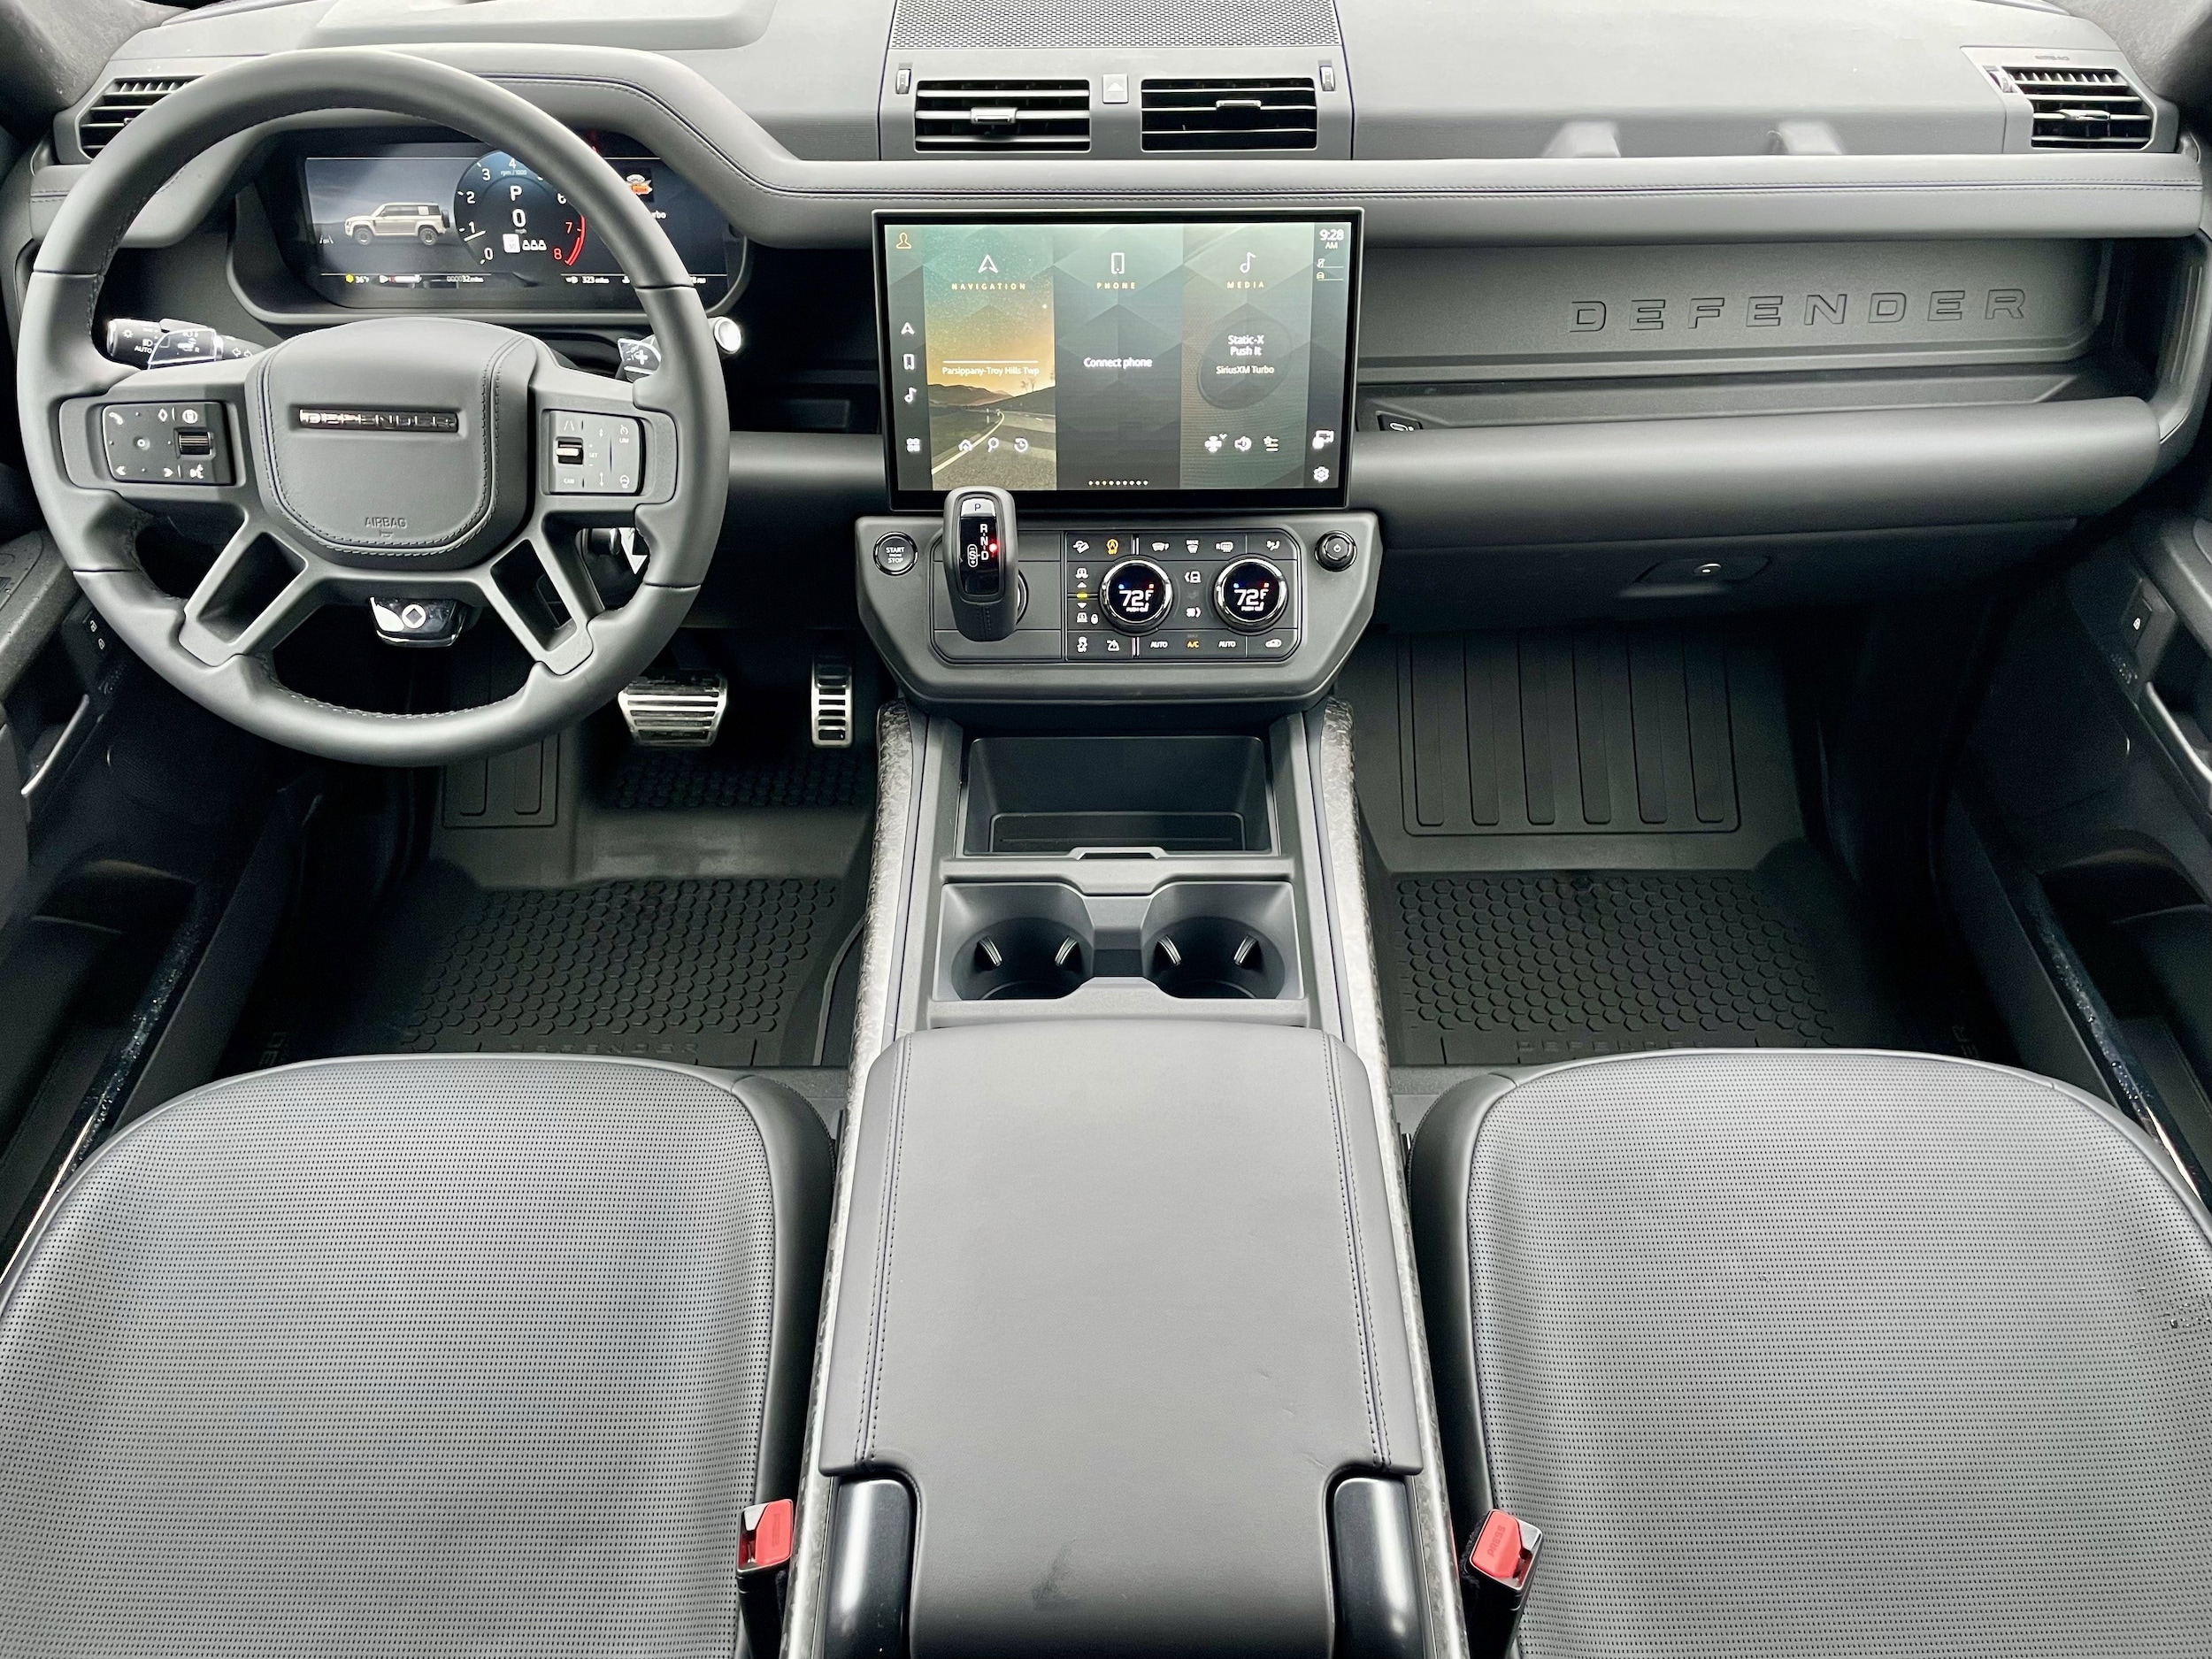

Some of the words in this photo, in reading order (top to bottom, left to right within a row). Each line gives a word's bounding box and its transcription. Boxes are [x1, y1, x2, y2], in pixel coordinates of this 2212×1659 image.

[509, 157, 517, 169] 4
[481, 168, 491, 181] 3
[466, 190, 476, 204] 2
[510, 185, 522, 201] P
[512, 209, 526, 228] 0
[468, 221, 476, 234] 1
[565, 221, 573, 234] 7
[1319, 228, 1345, 242] 9:28
[484, 247, 494, 261] 0
[553, 248, 563, 260] 8
[951, 282, 1026, 291] NAVIGATION
[1226, 280, 1265, 289] MEDIA
[1569, 288, 2025, 333] DEFENDER
[1227, 334, 1265, 345] Static-X
[1230, 345, 1253, 356] Push
[1083, 357, 1122, 368] Connect
[1123, 357, 1154, 370] phone
[1216, 365, 1251, 374] SiriusXM
[1251, 365, 1275, 374] Turbo
[941, 365, 1003, 376] Parsippany-Troy
[1004, 366, 1022, 375] Hills
[1023, 366, 1041, 376] Twp
[365, 517, 408, 528] AIRBAG
[979, 523, 988, 534] R
[980, 536, 988, 546] N
[981, 550, 989, 560] D
[1217, 640, 1237, 649] AUTO
